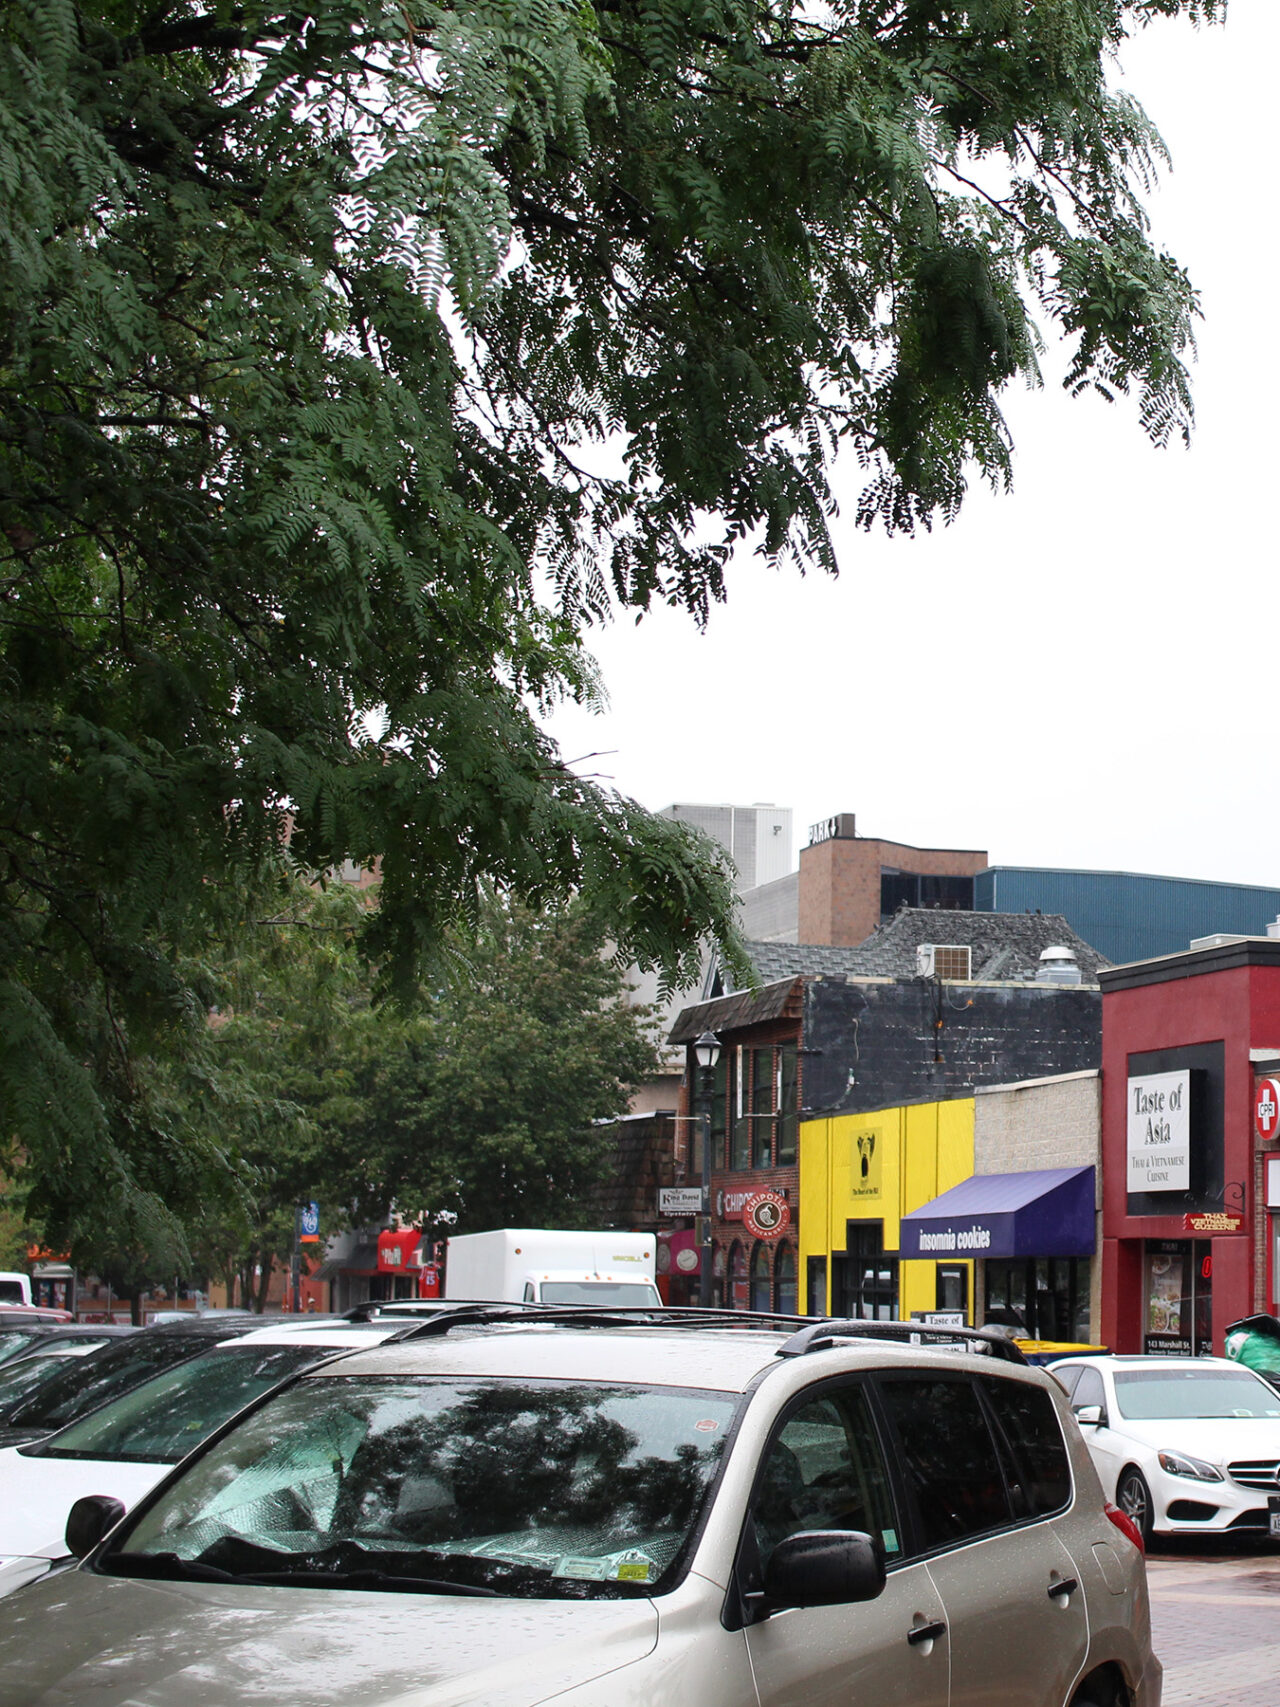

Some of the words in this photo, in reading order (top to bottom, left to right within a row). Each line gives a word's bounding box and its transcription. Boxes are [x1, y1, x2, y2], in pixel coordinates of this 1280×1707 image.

[808, 819, 830, 845] PARK
[1134, 1086, 1165, 1115] Taste
[1169, 1082, 1183, 1111] of
[1260, 1103, 1274, 1116] CPR
[1144, 1117, 1171, 1145] Asia
[746, 1193, 788, 1212] CHIPOTLE
[919, 1228, 956, 1251] insomnia
[957, 1225, 991, 1250] cookies
[929, 1316, 949, 1325] Taste
[1158, 1340, 1183, 1349] Marshall
